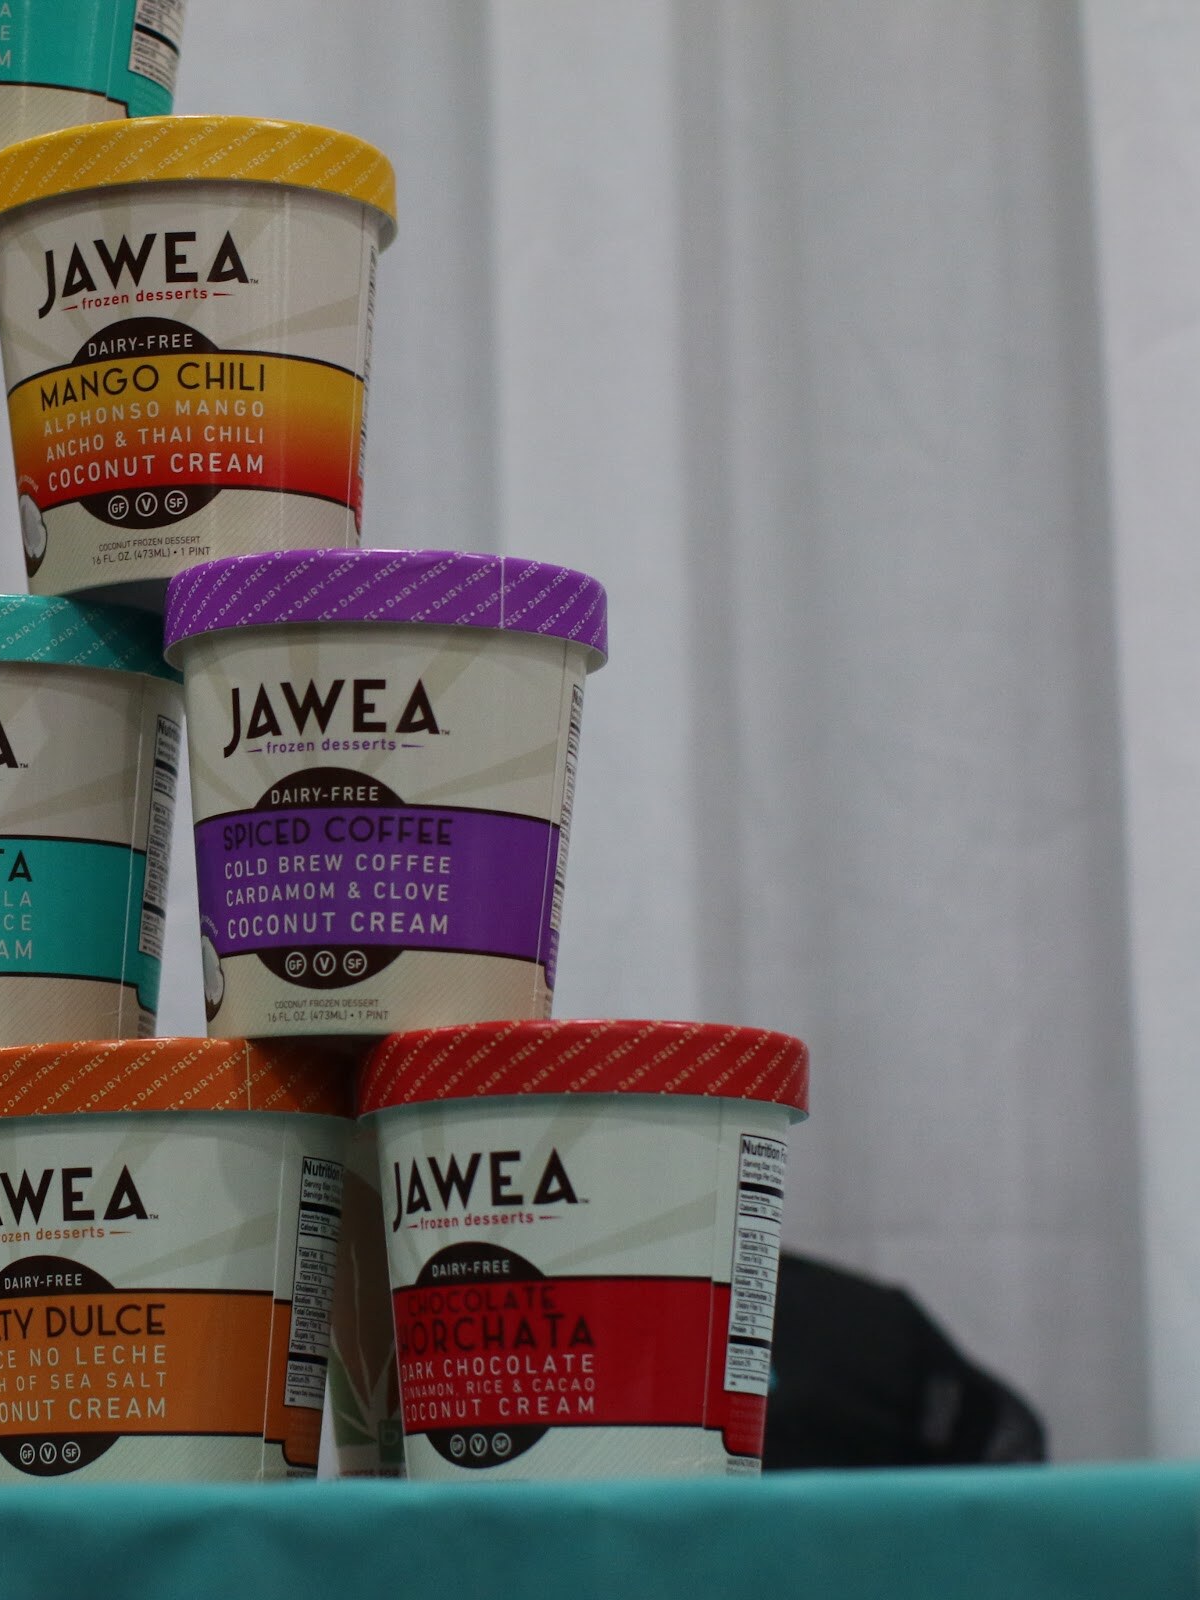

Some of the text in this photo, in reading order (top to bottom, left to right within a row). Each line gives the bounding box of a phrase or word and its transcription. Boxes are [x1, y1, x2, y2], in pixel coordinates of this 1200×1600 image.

[38, 230, 250, 319] JAWEA
[82, 288, 208, 309] frozen desserts
[88, 334, 194, 357] DAIRY-FREE
[40, 362, 265, 411] MANGO CHILI
[44, 400, 264, 438] ALPHONSO MANGO
[46, 427, 264, 462] ANCHO & THAI CHILI
[48, 455, 155, 491] COCONUT
[170, 453, 264, 474] CREAM
[99, 536, 200, 552] COCONUT FROZEN DESSERT
[137, 548, 171, 561] (473ML)
[187, 546, 210, 556] PINT
[224, 677, 440, 758] JAWEA
[266, 738, 396, 755] frozen desserts
[271, 786, 379, 805] DAIRY-FREE
[224, 815, 453, 852] SPICED COFFEE
[225, 853, 451, 879] COLD BREW COFFEE
[226, 882, 450, 907] CARDAMOM & CLOVE
[228, 912, 336, 939] COCONUT
[350, 911, 448, 935] CREAM
[313, 1010, 347, 1021] (473ML)
[365, 1010, 388, 1020] PINT
[741, 1139, 780, 1158] Nutrition
[303, 1160, 339, 1181] Nutrition
[393, 1147, 579, 1232] JAWEA
[420, 1212, 533, 1230] frozen desserts
[36, 1227, 104, 1240] desserts
[432, 1260, 510, 1277] DAIRY-FREE
[4, 1273, 82, 1289] DAIRY-FREE
[409, 1287, 555, 1316] CHOCOLATE
[46, 1304, 165, 1338] DULCE
[30, 1347, 60, 1366] NO
[76, 1345, 165, 1365] LECHE
[402, 1354, 594, 1381] DARK CHOCOLATE
[16, 1375, 37, 1390] OF
[51, 1373, 91, 1389] SEA
[107, 1372, 166, 1388] SALT
[467, 1377, 594, 1393] RICE & CACAO
[69, 1399, 165, 1420] CREAM
[405, 1398, 594, 1422] COCONUT CREAM
